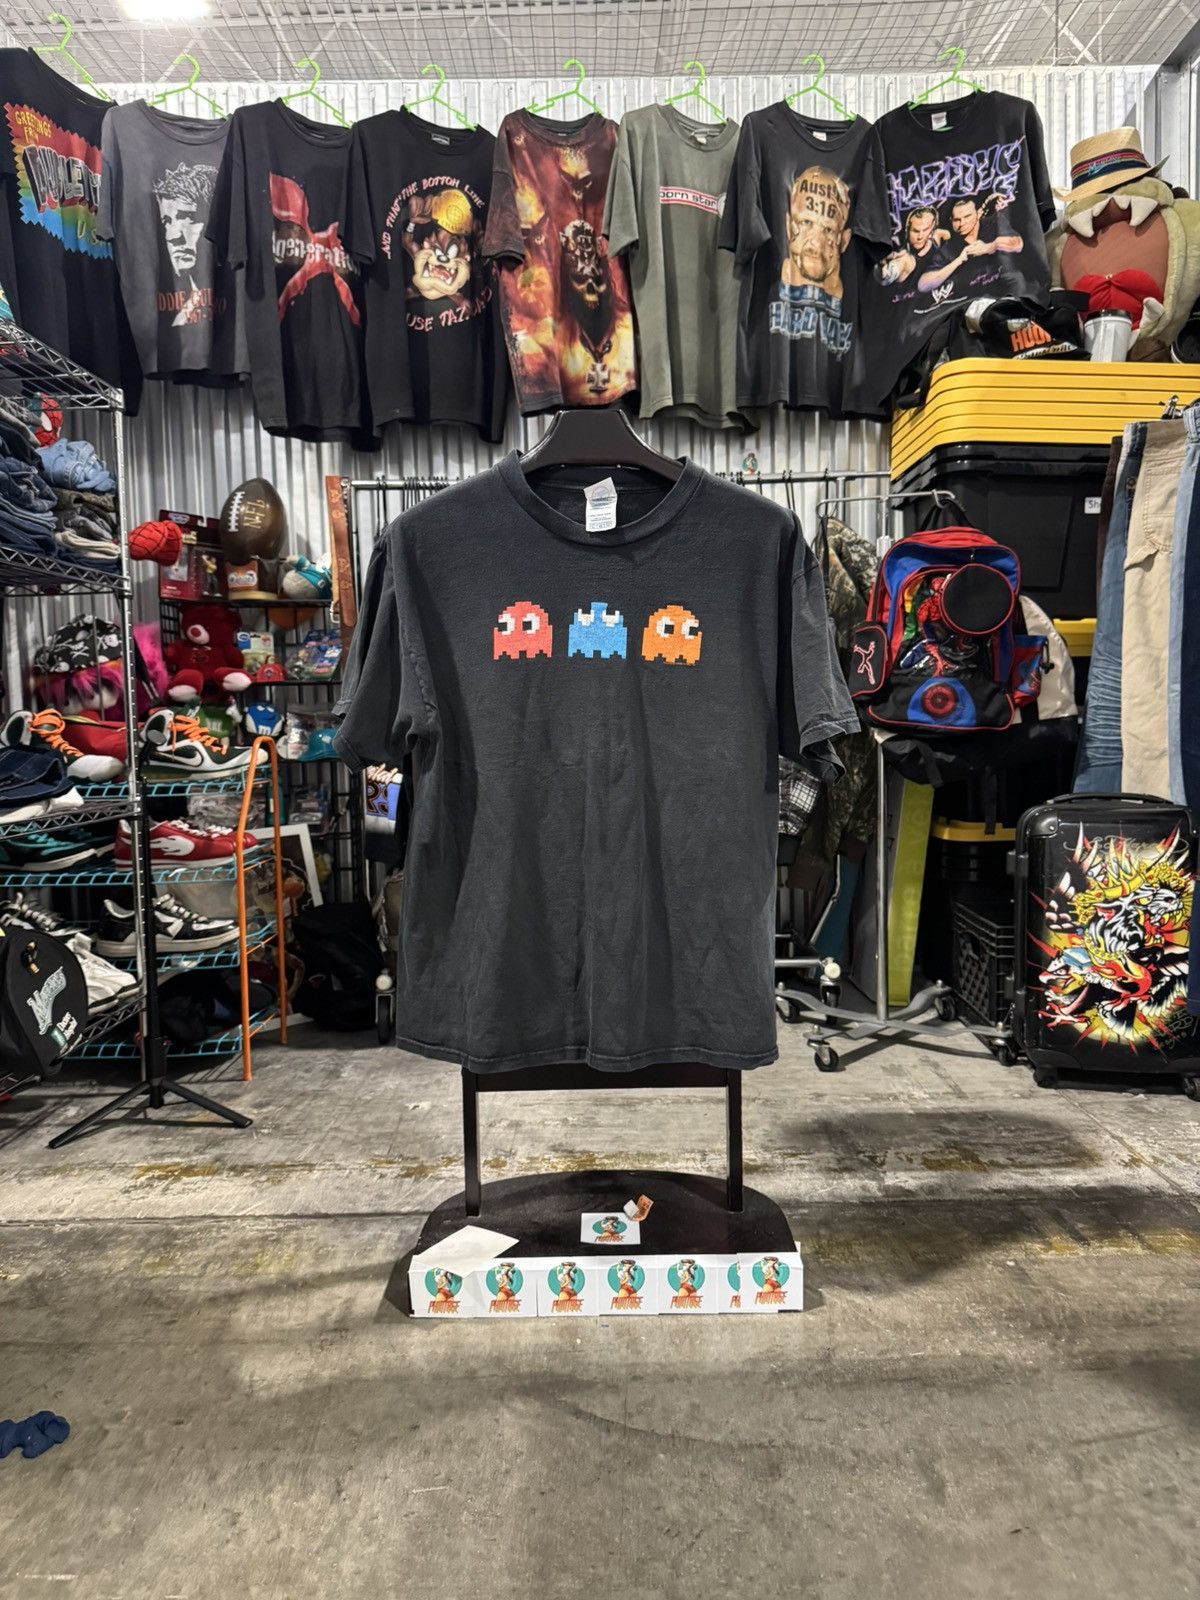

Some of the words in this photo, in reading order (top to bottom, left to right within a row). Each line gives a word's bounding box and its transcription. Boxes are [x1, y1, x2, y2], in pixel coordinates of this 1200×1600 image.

[401, 182, 418, 200] THE
[422, 176, 460, 190] BOTTOM
[806, 196, 837, 218] 3:16
[243, 499, 265, 529] NFL
[1089, 500, 1100, 509] Sh
